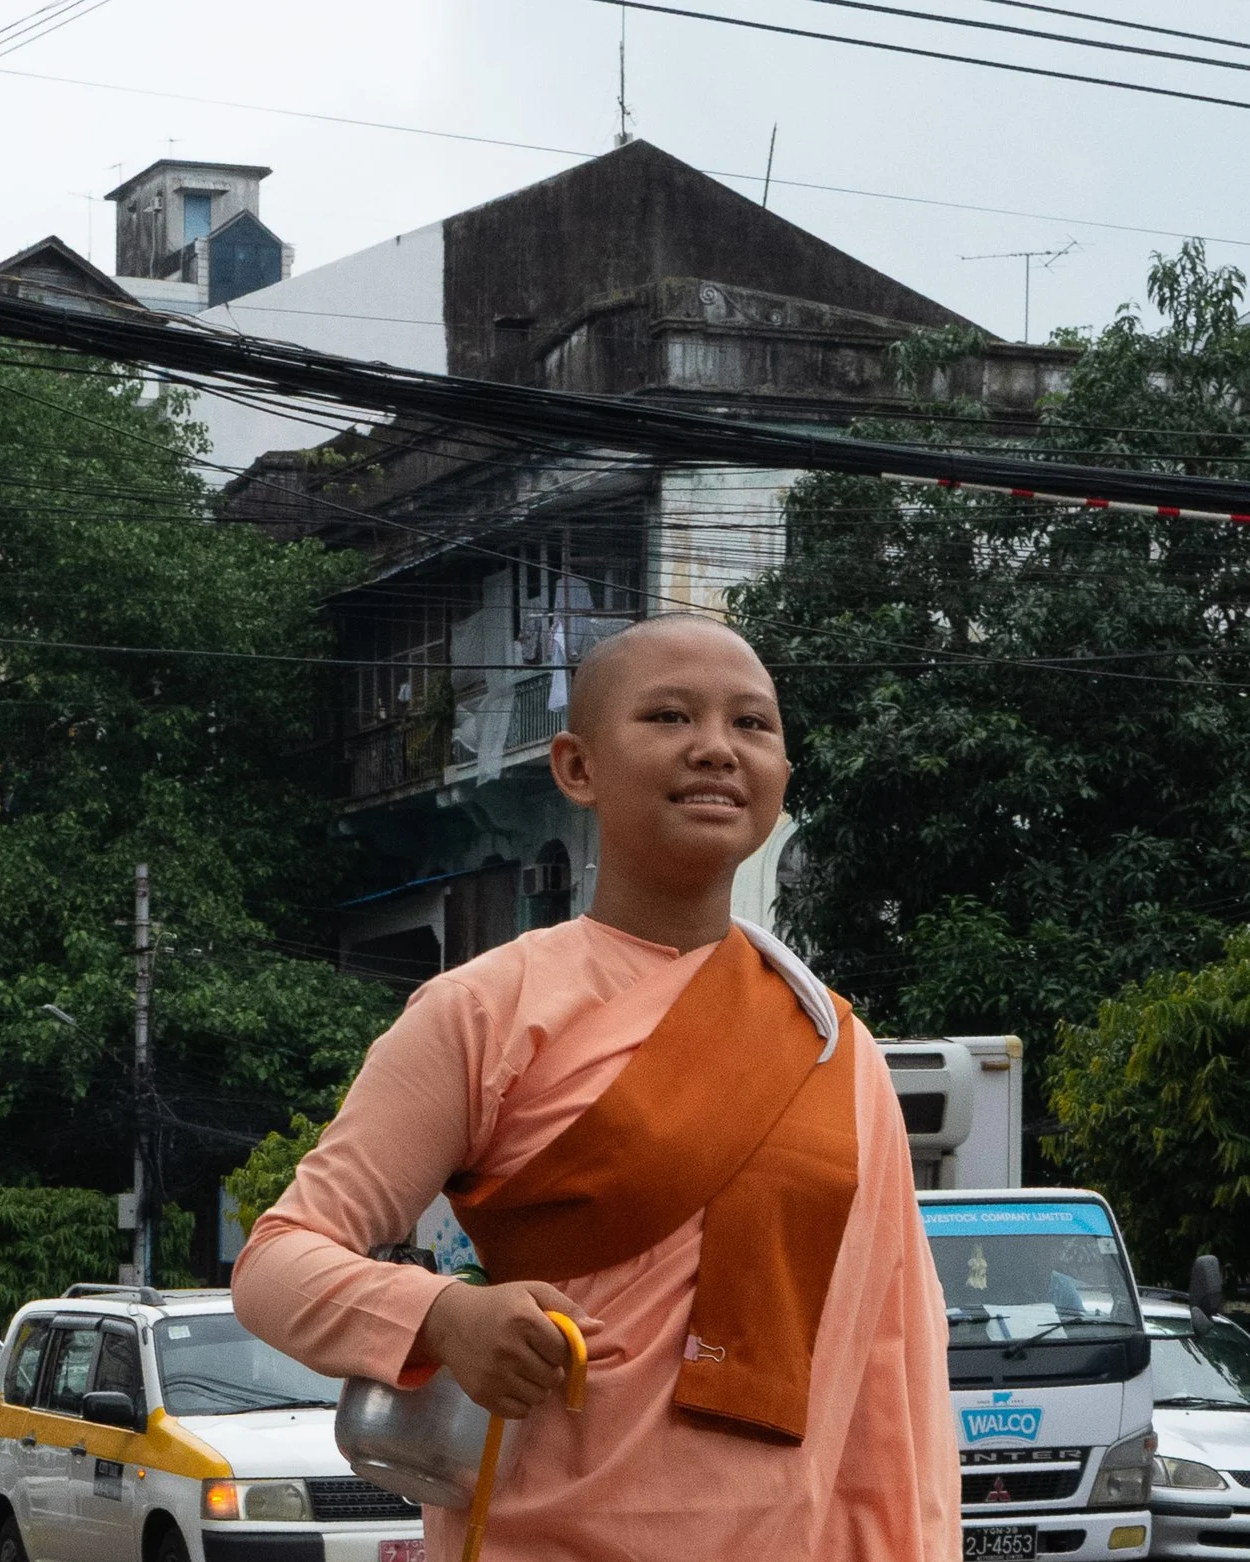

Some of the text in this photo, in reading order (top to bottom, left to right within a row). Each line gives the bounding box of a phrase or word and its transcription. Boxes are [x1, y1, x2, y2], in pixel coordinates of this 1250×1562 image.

[981, 1212, 1031, 1223] COMPANY
[1033, 1212, 1073, 1222] LIMITED
[968, 1413, 1036, 1436] WALCO
[965, 1534, 1033, 1556] 2J-4553
